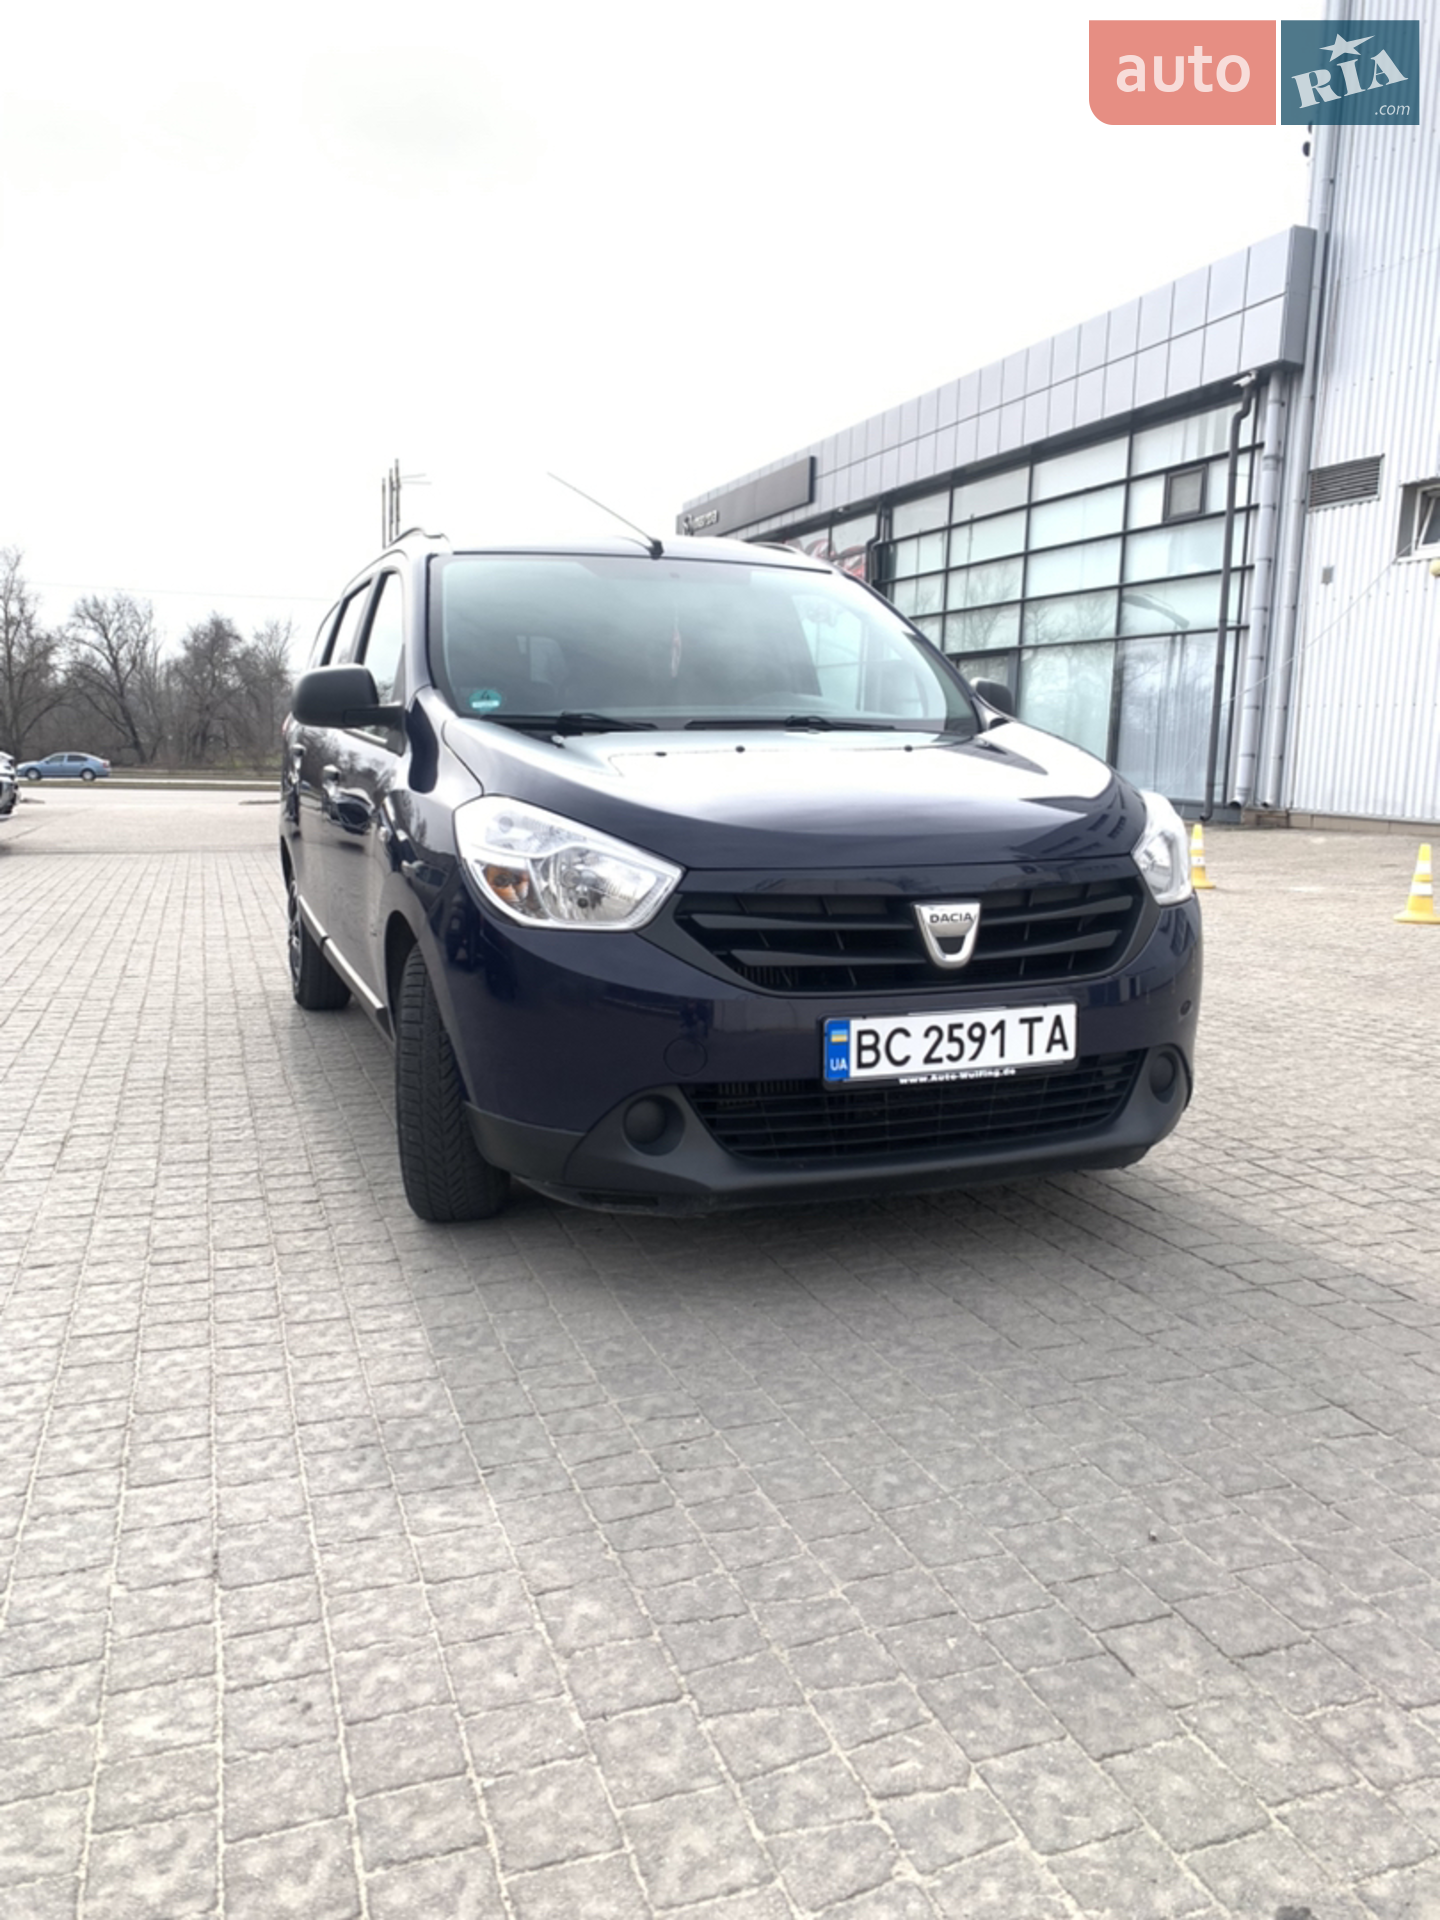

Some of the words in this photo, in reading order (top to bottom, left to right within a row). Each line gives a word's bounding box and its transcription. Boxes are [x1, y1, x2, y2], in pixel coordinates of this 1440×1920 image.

[929, 912, 973, 924] DACIA
[856, 1027, 912, 1070] BC
[922, 1019, 1006, 1065] 2591
[1018, 1014, 1069, 1057] TA
[829, 1057, 848, 1071] UA
